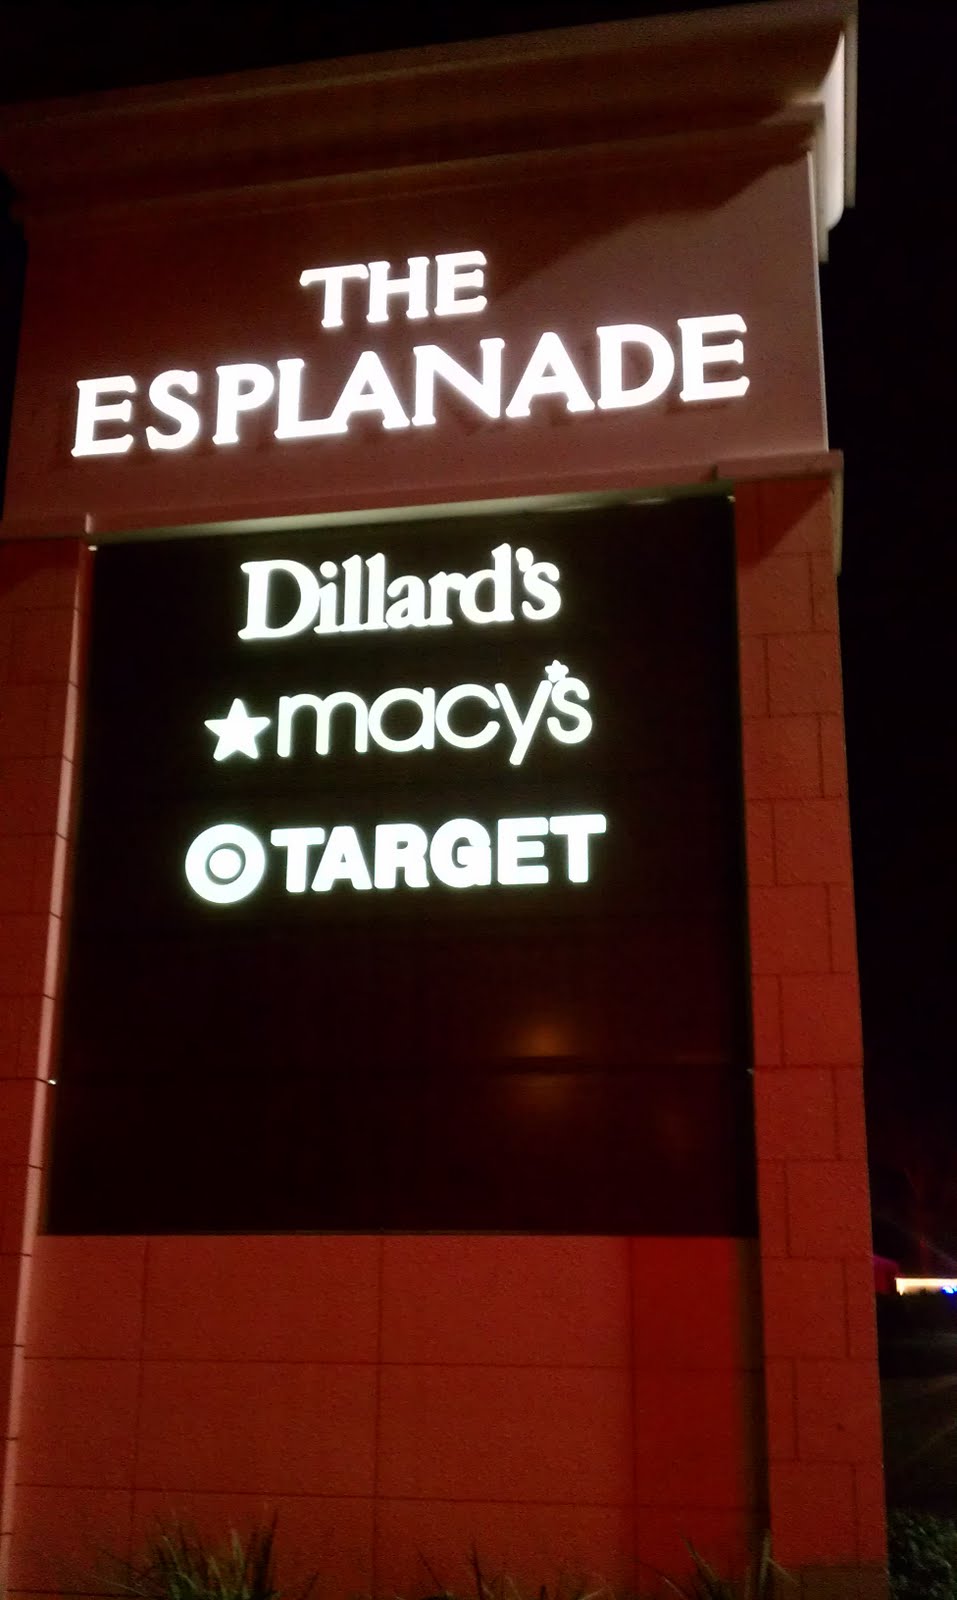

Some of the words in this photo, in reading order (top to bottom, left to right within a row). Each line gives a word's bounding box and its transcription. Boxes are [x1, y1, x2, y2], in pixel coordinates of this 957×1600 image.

[299, 250, 487, 328] THE
[71, 314, 750, 458] ESPLANADE
[238, 543, 562, 640] Dillard's
[277, 660, 593, 766] macy's
[270, 813, 607, 893] TARGET
